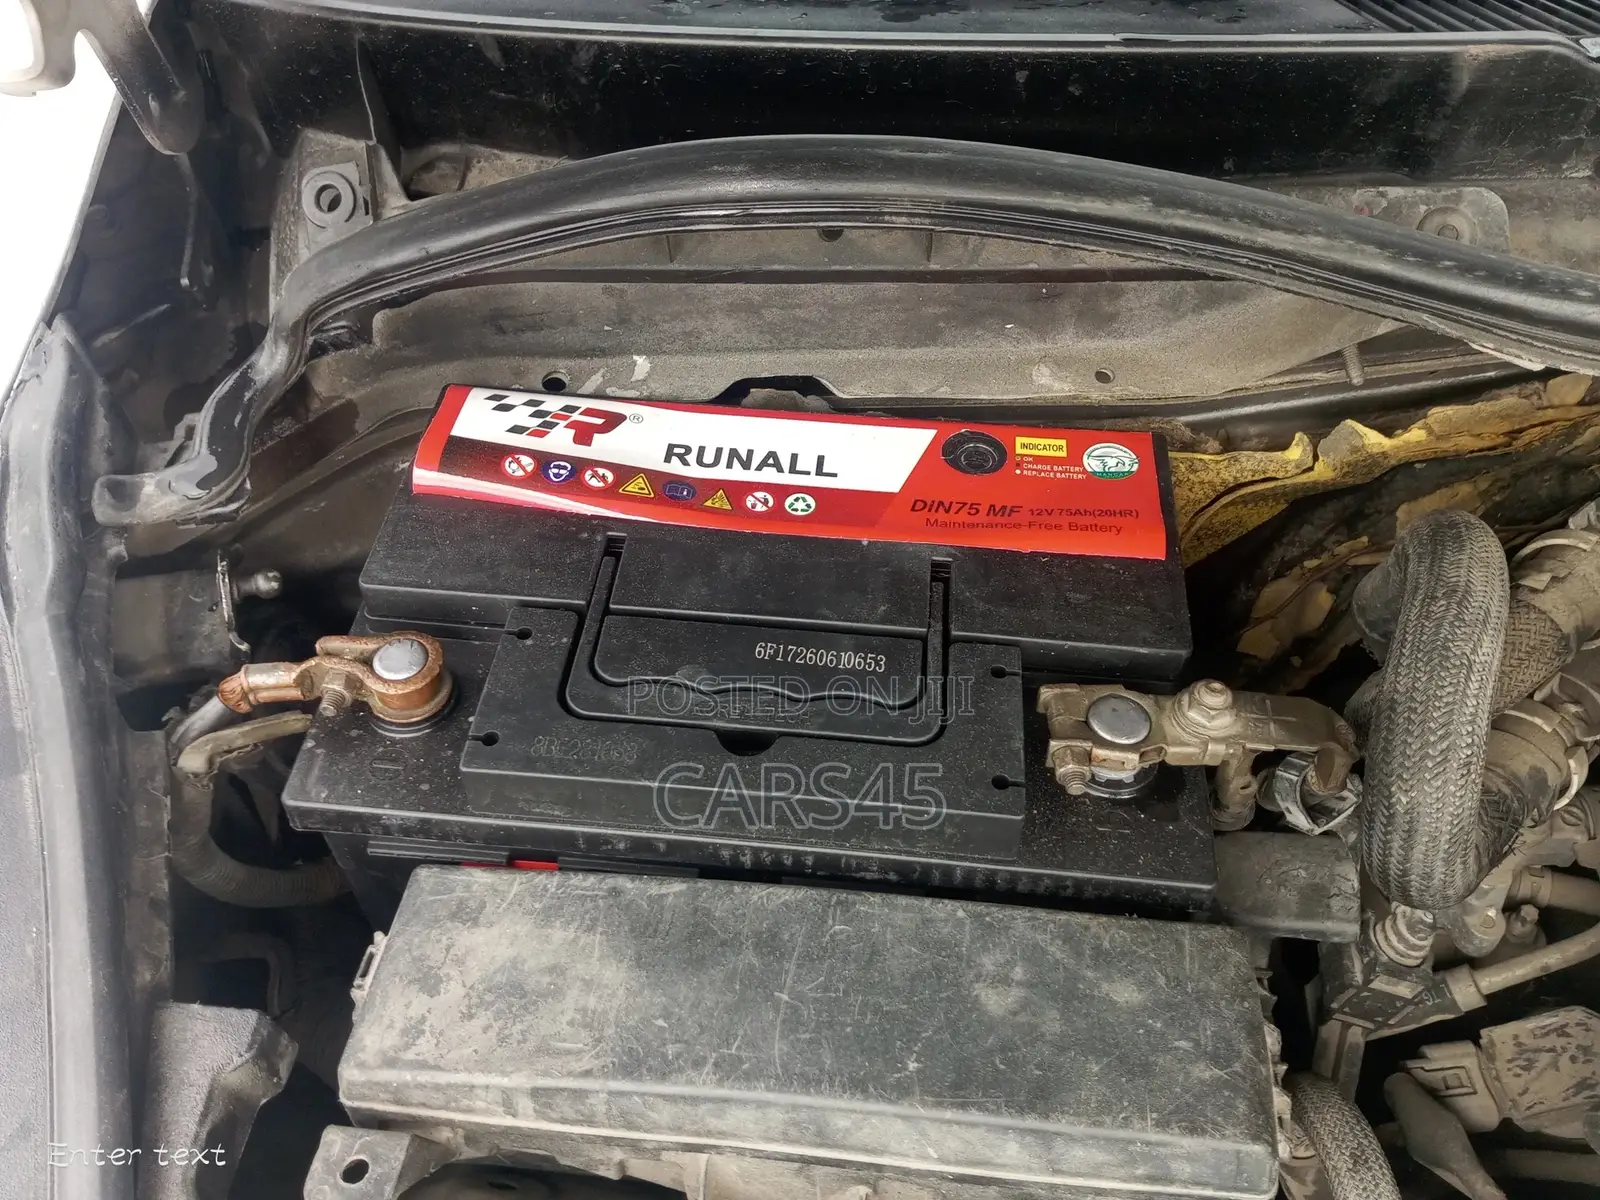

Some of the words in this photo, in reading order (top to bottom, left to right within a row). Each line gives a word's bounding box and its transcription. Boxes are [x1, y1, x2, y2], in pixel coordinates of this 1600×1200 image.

[1020, 442, 1064, 452] INDICATOR
[663, 442, 839, 478] RUNALL
[1022, 463, 1051, 471] CHARGE
[1053, 465, 1084, 473] BATTERY
[1022, 470, 1055, 478] REPLACE
[1056, 472, 1087, 480] BATTERY
[910, 498, 982, 516] DIN75
[985, 504, 1022, 517] MF
[1028, 509, 1054, 517] 12V
[1057, 508, 1140, 519] 75Ah(20HR)
[925, 516, 1063, 531] Maintenance-Free
[1068, 520, 1123, 535] Battery
[754, 642, 887, 673] 6F17260610653
